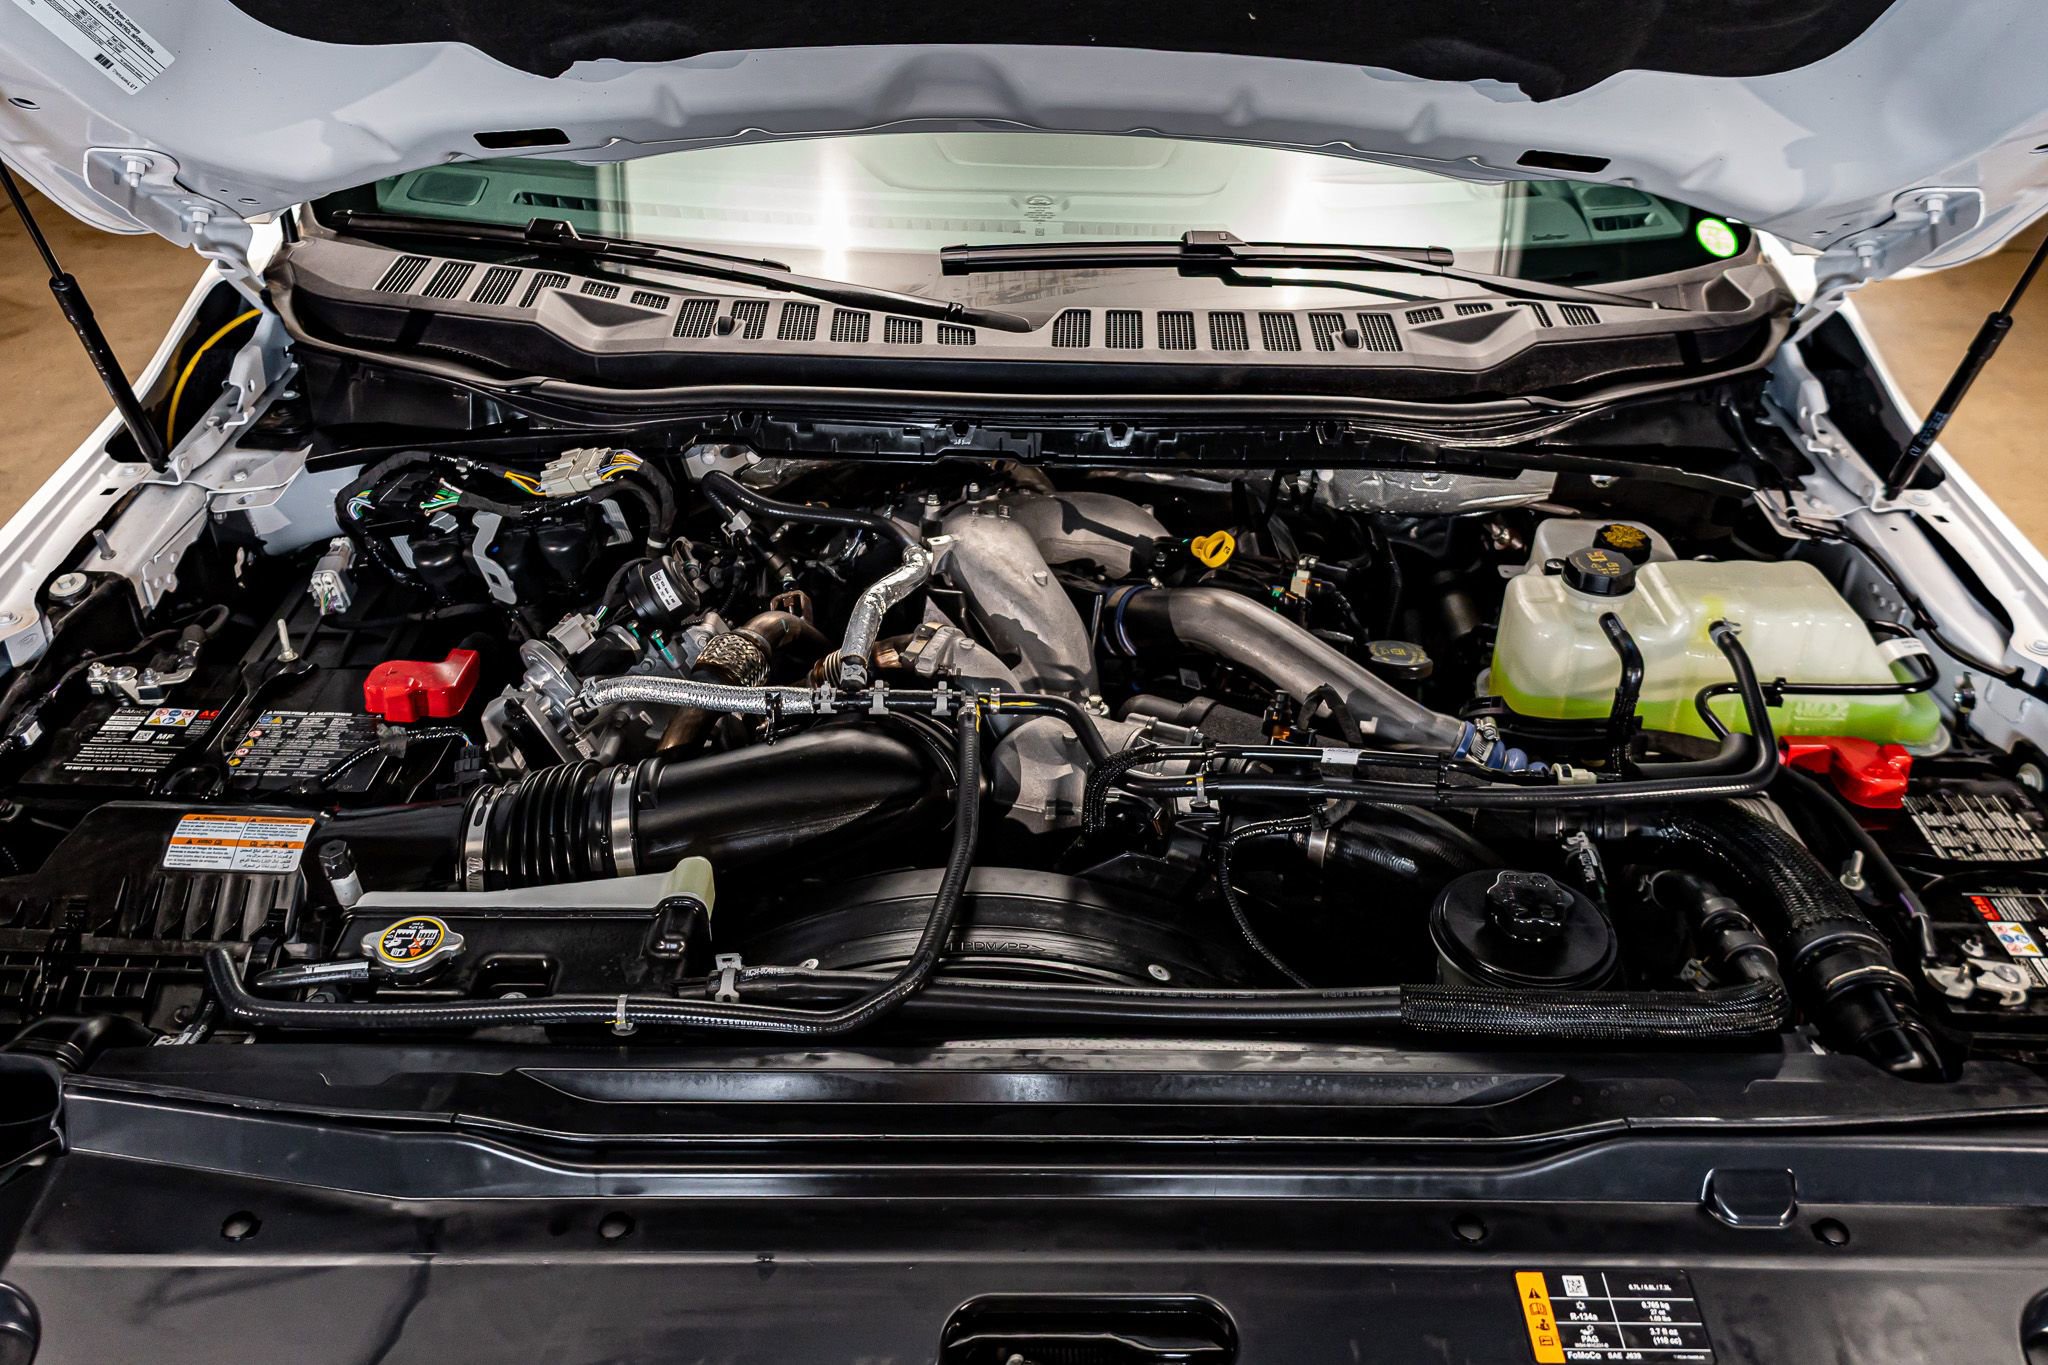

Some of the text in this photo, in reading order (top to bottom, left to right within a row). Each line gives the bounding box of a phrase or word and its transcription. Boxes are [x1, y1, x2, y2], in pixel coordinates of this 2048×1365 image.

[106, 3, 141, 34] Ford Motor Company
[96, 3, 155, 54] EMISSION CONTROL INFORMATION
[1660, 1301, 1670, 1311] kg
[1570, 1312, 1598, 1321] R-134a
[1581, 1335, 1600, 1343] PAG
[1567, 1351, 1602, 1360] FoMoCo
